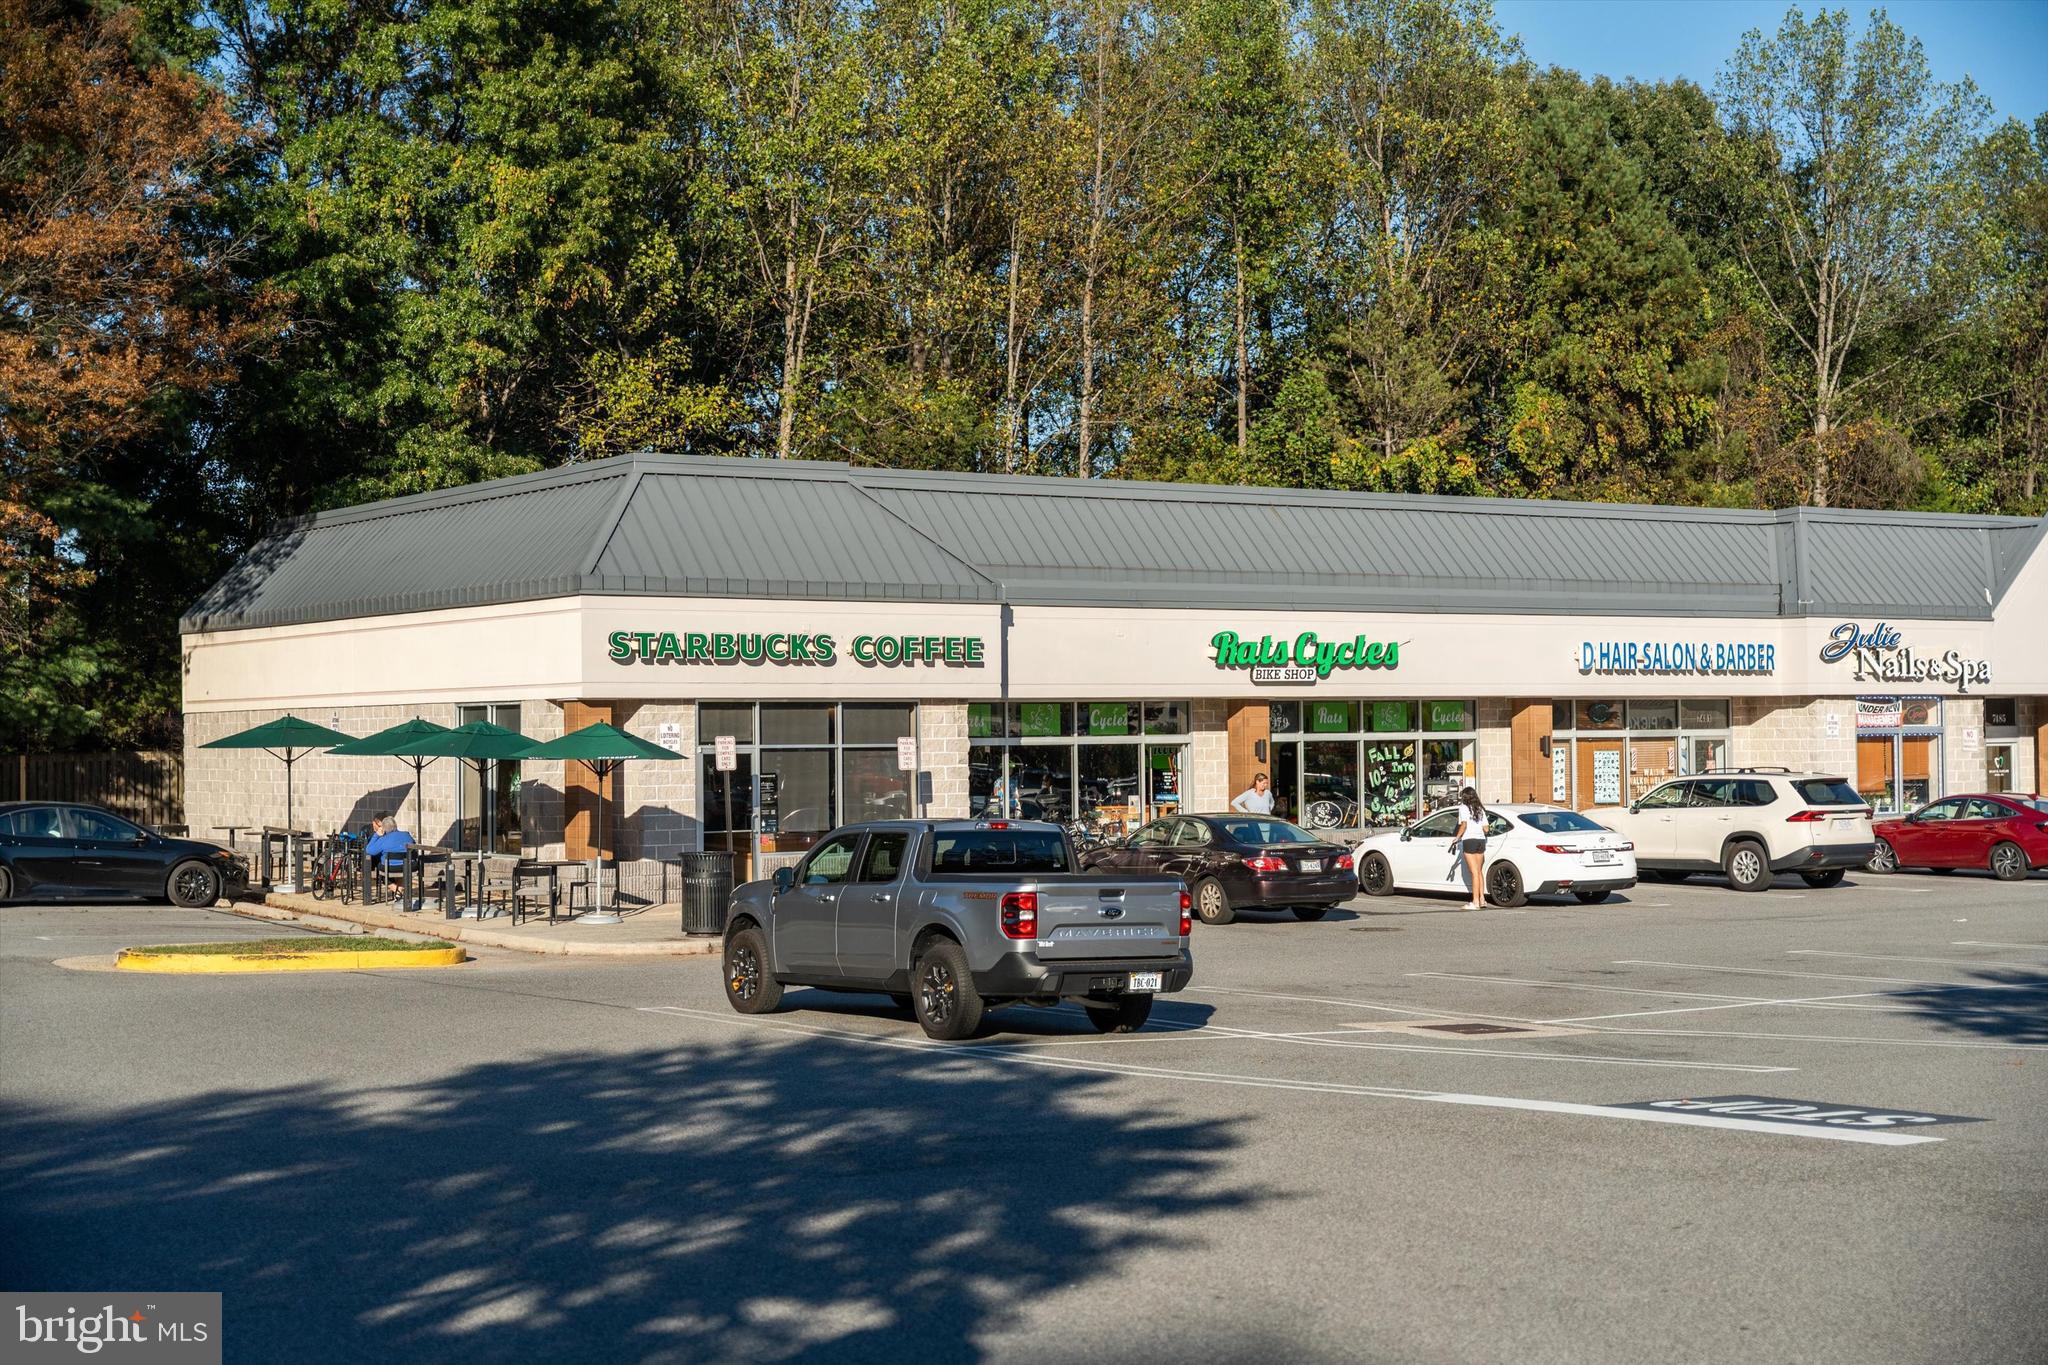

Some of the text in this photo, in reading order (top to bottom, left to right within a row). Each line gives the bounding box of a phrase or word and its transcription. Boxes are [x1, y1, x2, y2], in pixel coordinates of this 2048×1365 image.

[609, 631, 985, 663] STARBUCKS COFFEE
[1824, 622, 1901, 658] Julie
[1211, 630, 1399, 676] Rats Cycles
[1583, 642, 1594, 669] D
[1700, 643, 1711, 670] &
[1716, 643, 1775, 670] BARBER
[1255, 669, 1314, 680] BIKE SHOP
[1318, 707, 1343, 724] Rats
[1432, 706, 1465, 724] Cycles
[1857, 702, 1900, 714] UNDER NEW
[1090, 710, 1128, 730] Cycles
[1858, 714, 1900, 724] MANAGEMENT
[1368, 746, 1401, 763] FALL
[1392, 762, 1416, 772] INTO
[1059, 927, 1160, 937] MAVERICK
